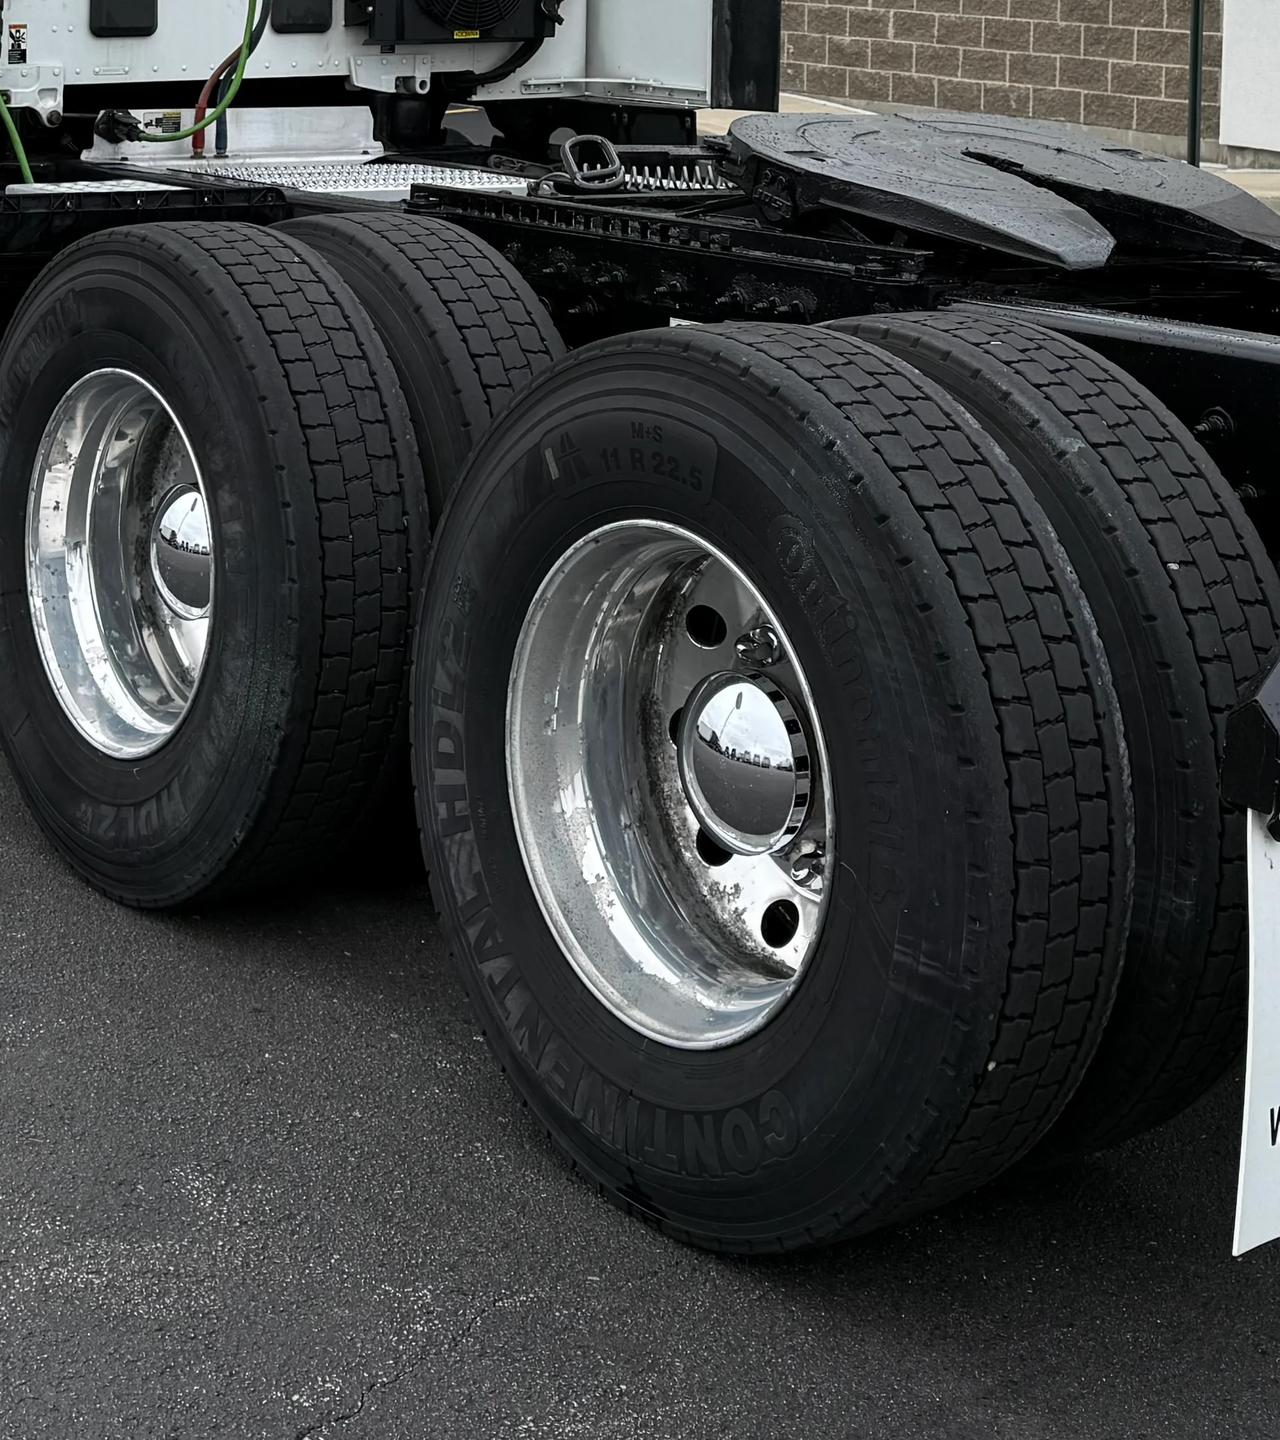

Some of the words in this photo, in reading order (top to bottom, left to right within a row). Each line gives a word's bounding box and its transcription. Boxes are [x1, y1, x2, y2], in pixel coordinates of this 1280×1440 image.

[631, 421, 663, 443] M+S
[600, 447, 620, 472] 11
[629, 448, 645, 472] R
[650, 451, 703, 491] 22.5
